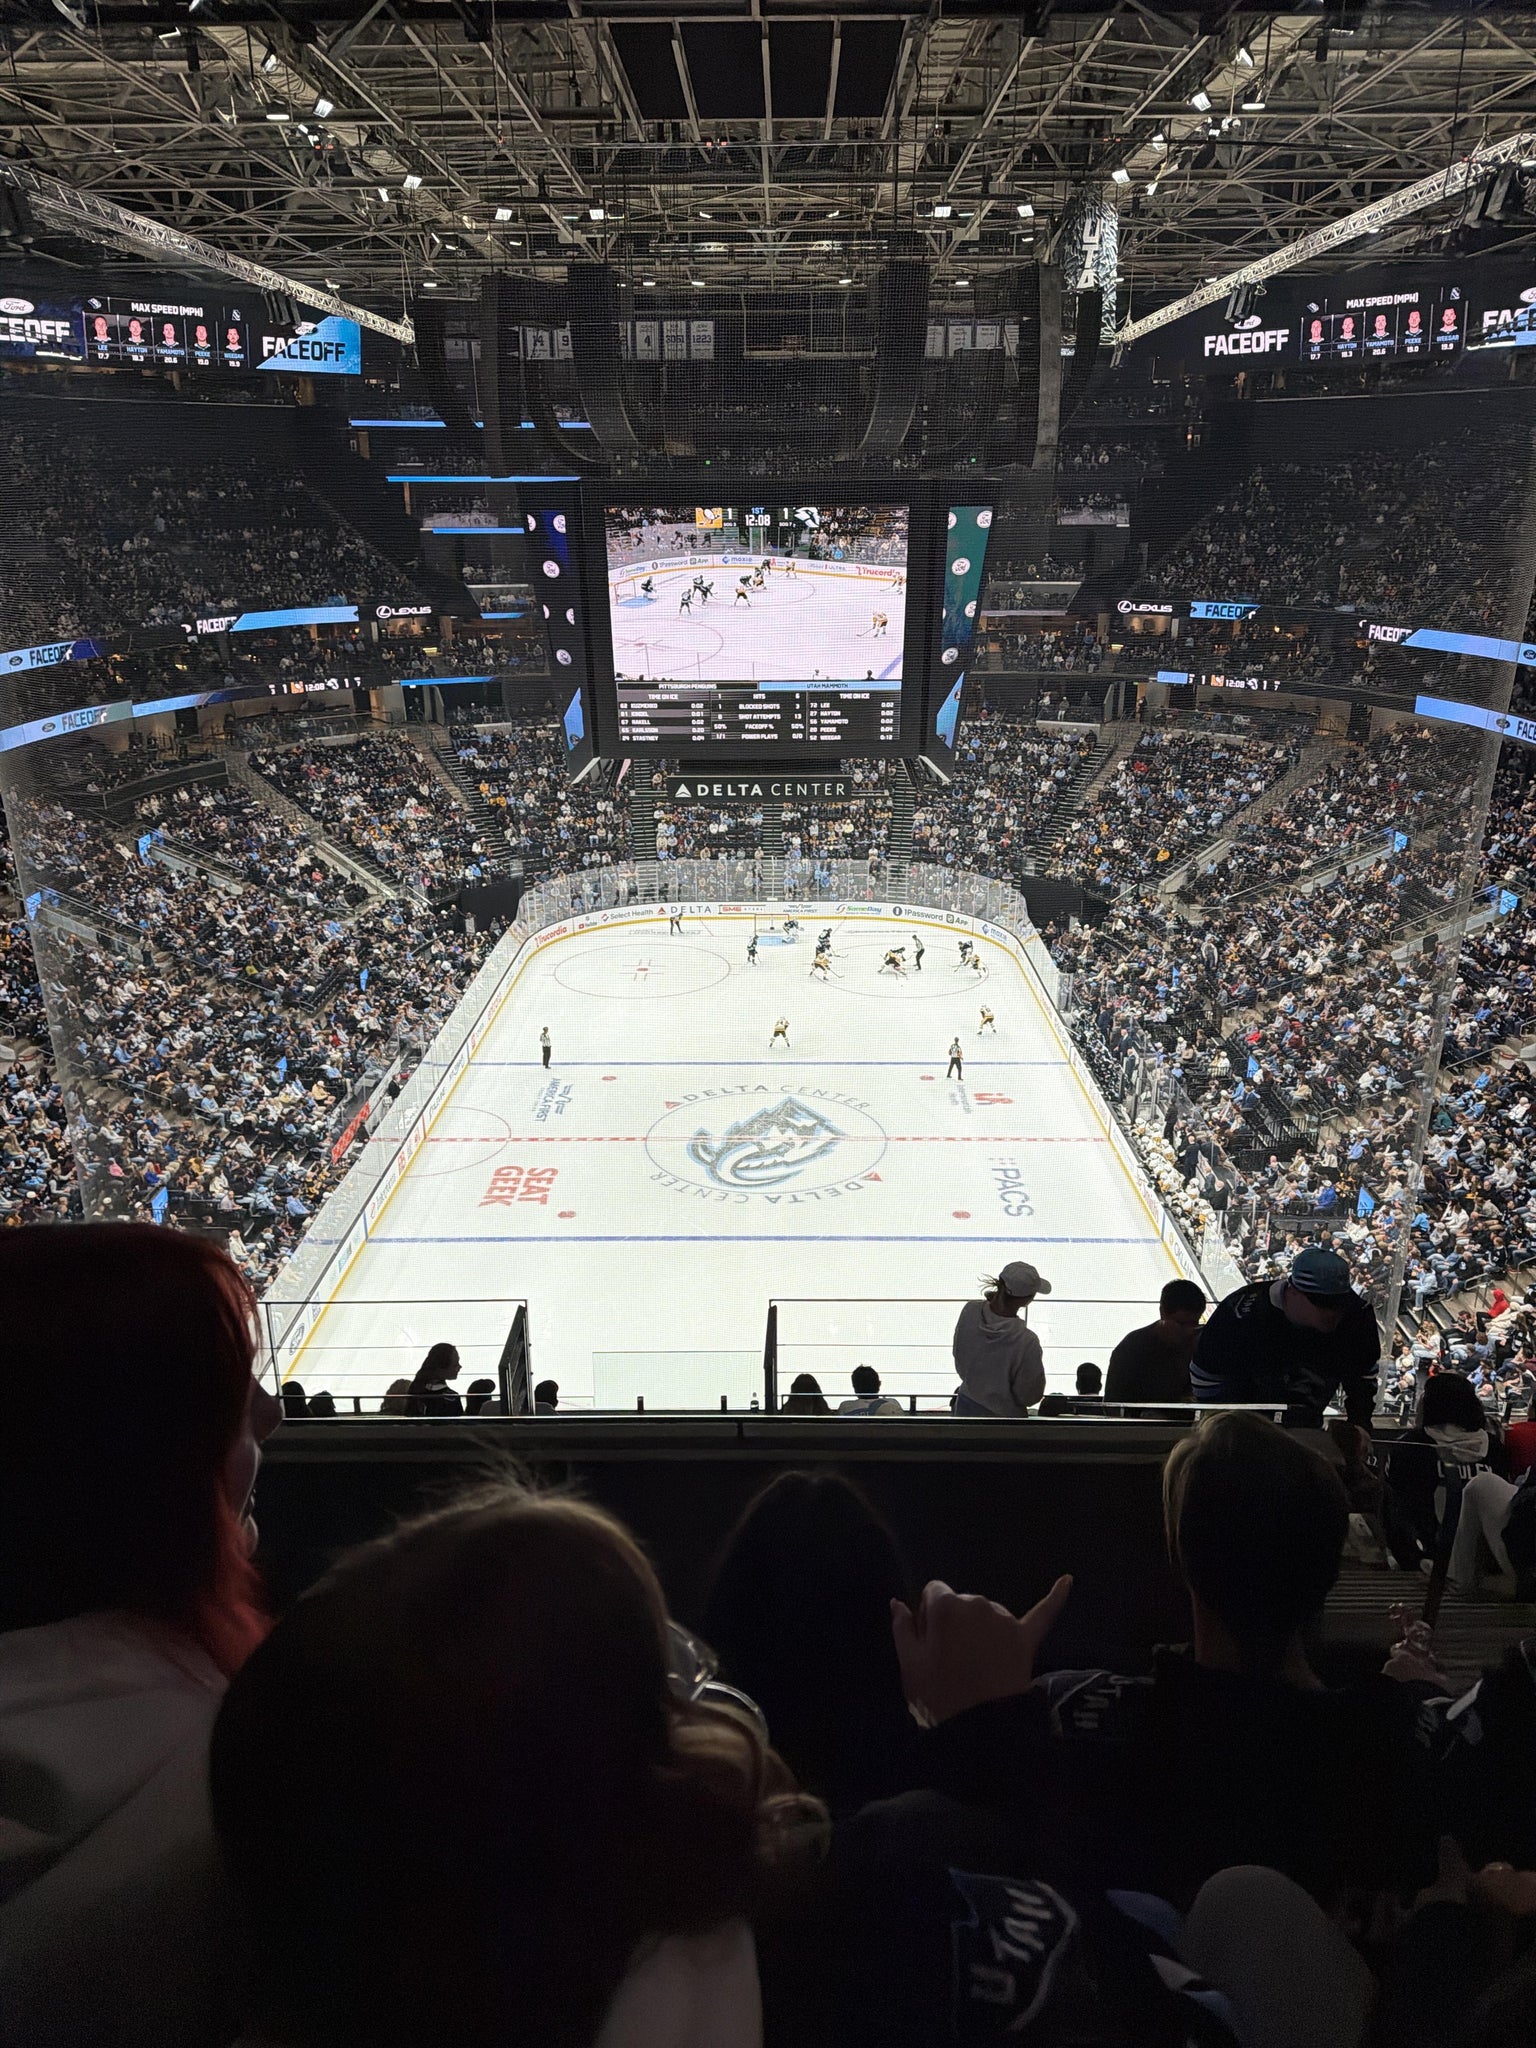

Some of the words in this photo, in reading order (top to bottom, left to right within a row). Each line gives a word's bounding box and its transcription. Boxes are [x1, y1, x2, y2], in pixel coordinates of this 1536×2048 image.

[1346, 298, 1364, 309] MAX
[1365, 295, 1393, 307] SPEED
[1394, 292, 1419, 304] (MPH)
[131, 302, 150, 312] MAX
[151, 303, 178, 315] SPEED
[180, 306, 203, 317] (MPH)
[262, 336, 346, 362] FACEOFF
[1204, 329, 1289, 357] FACEOFF
[728, 508, 733, 520] 1
[745, 514, 770, 526] 12:08
[783, 508, 789, 520] 1
[391, 606, 432, 616] LEXUS
[1132, 604, 1173, 613] LEXUS
[305, 683, 325, 692] 12:08
[1225, 679, 1246, 688] 12:08
[697, 784, 763, 796] DELTA
[770, 783, 845, 796] CENTER
[611, 912, 631, 920] Select
[632, 909, 653, 917] Health
[671, 905, 711, 914] DELTA
[904, 908, 944, 922] 1Password
[682, 1084, 769, 1102] DELTA
[779, 1084, 871, 1109] CENTER
[478, 1165, 525, 1207] GEEK
[517, 1167, 559, 1205] SEAT
[650, 1171, 749, 1204] CENTER
[764, 1181, 865, 1204] DELTA
[991, 1167, 1035, 1218] PACS
